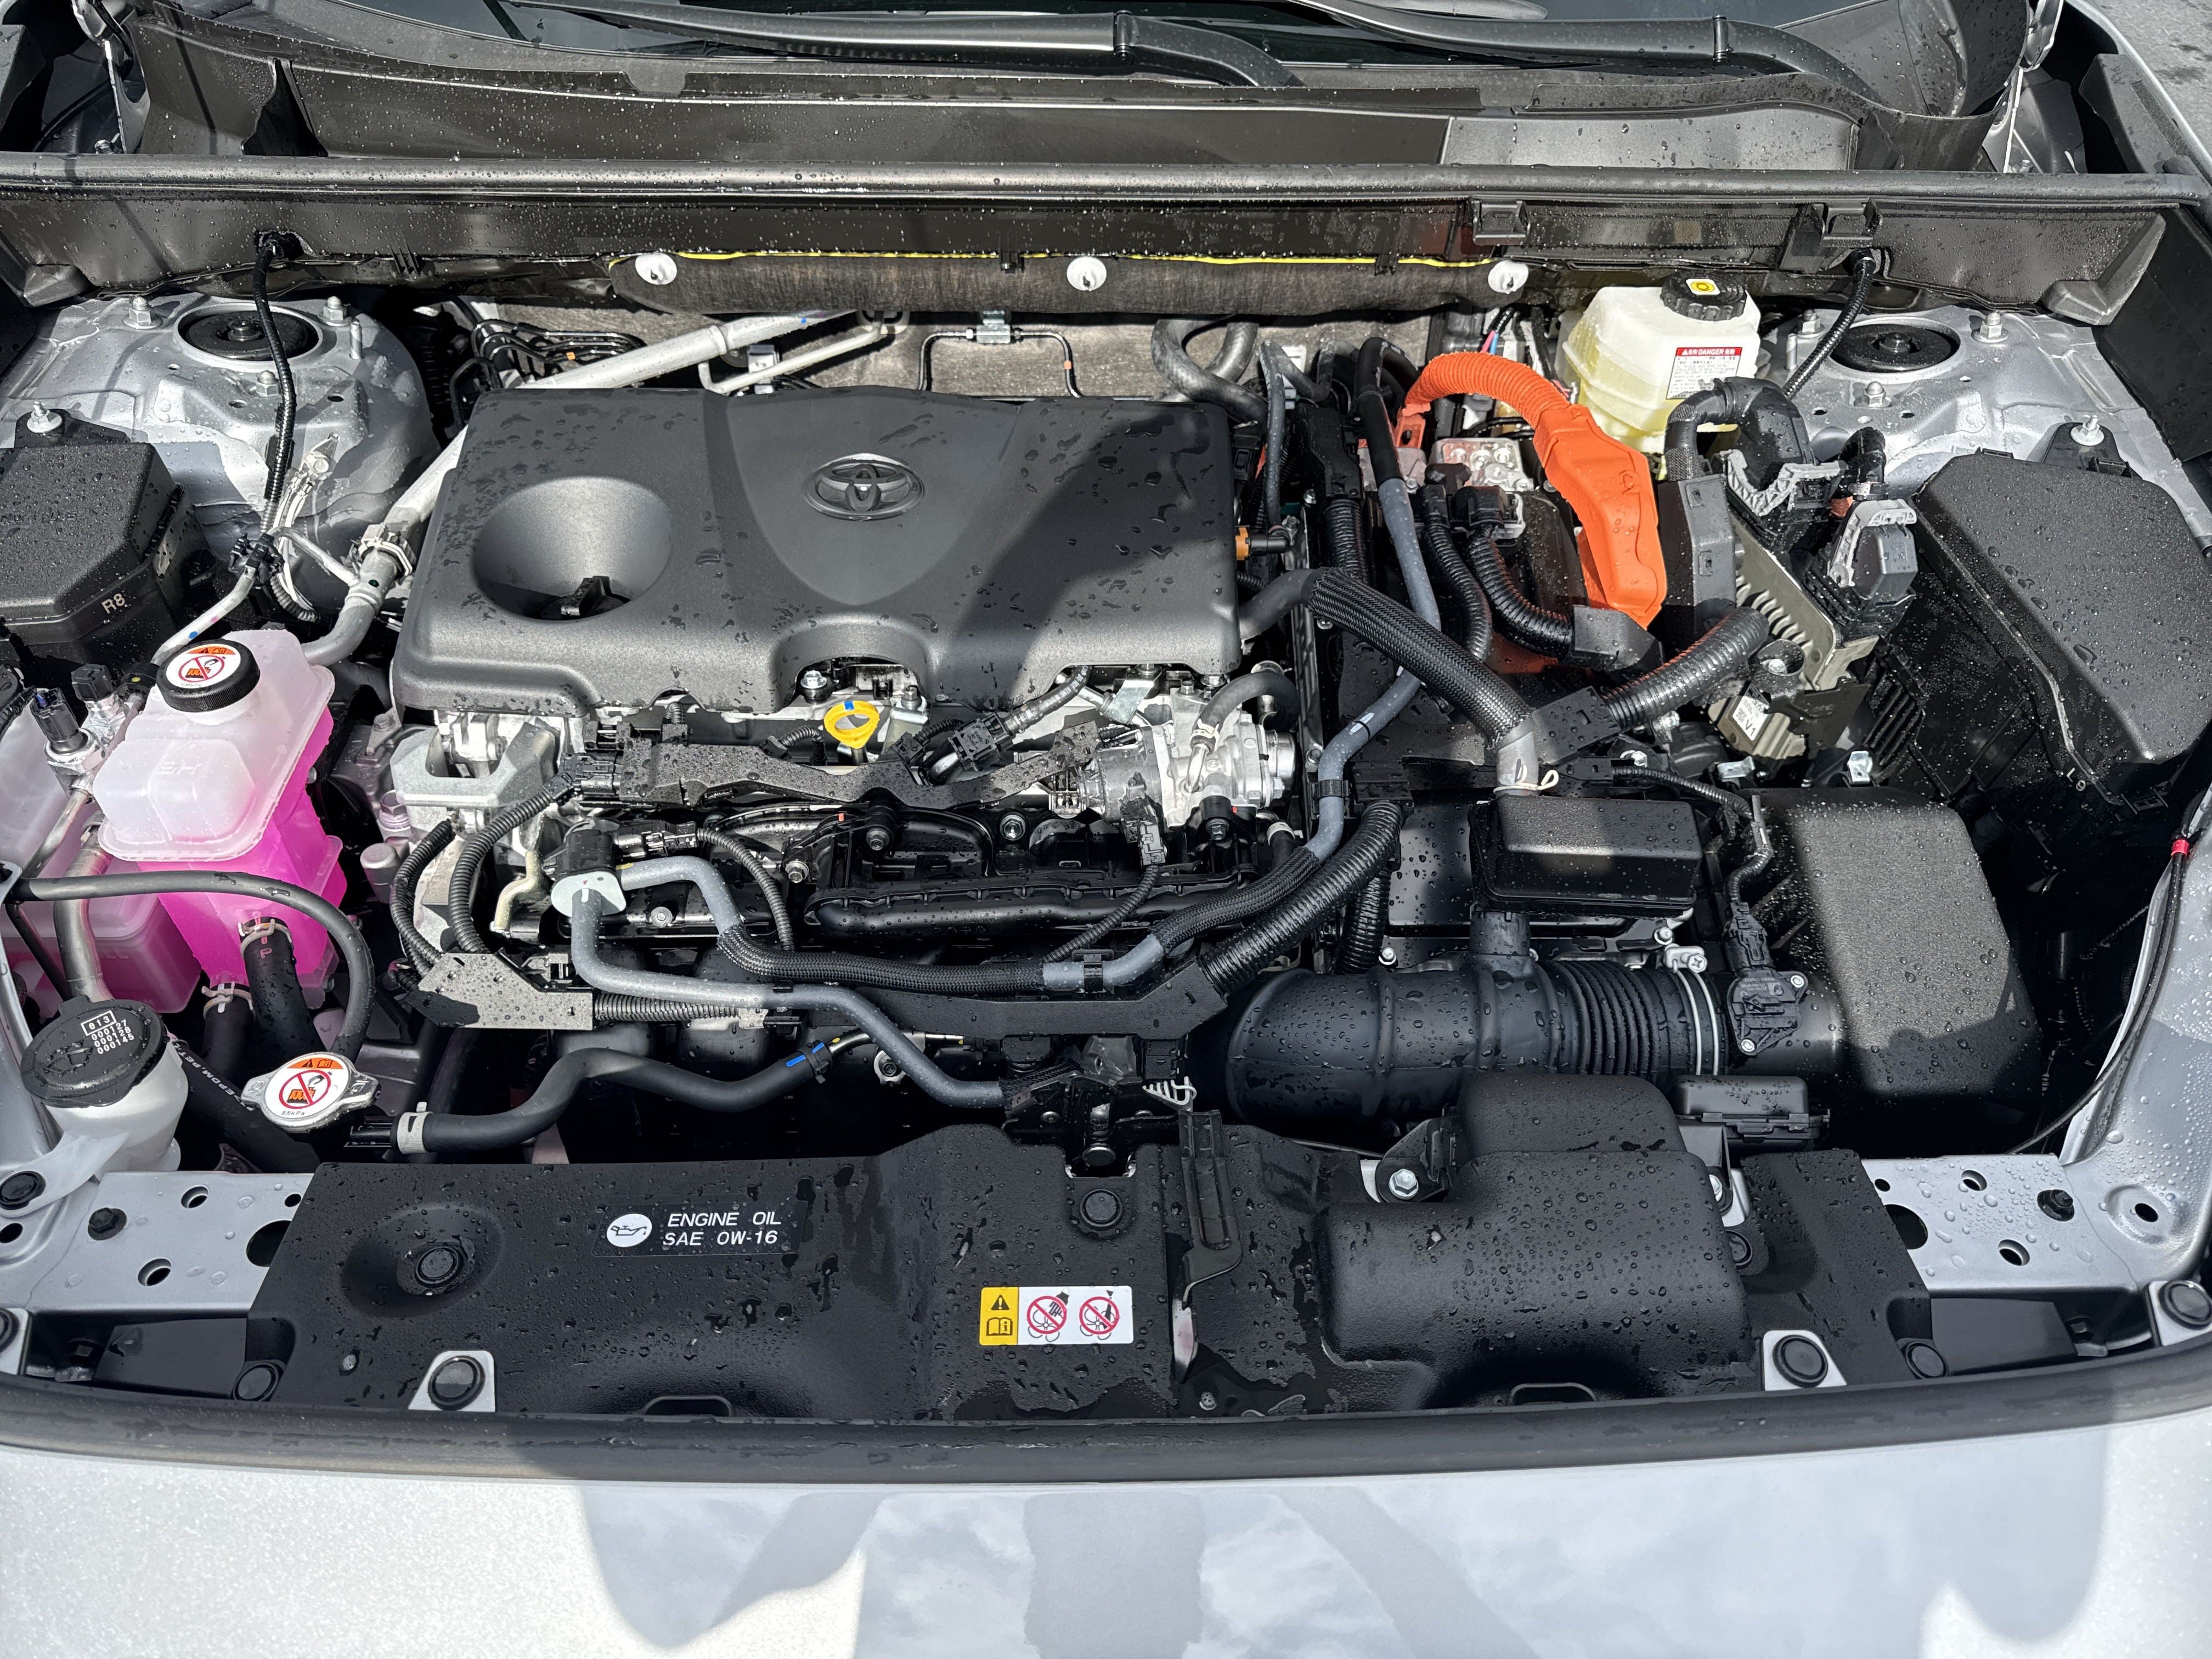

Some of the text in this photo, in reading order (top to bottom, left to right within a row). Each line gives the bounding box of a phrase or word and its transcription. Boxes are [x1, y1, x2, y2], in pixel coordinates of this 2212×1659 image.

[101, 593, 126, 614] R8
[1745, 719, 1756, 737] V1
[91, 1019, 127, 1041] 000127
[94, 1026, 131, 1047] 000128
[97, 1033, 134, 1054] 000145
[667, 1211, 782, 1227] ENGINE OIL
[663, 1230, 778, 1246] SAE 0W-16
